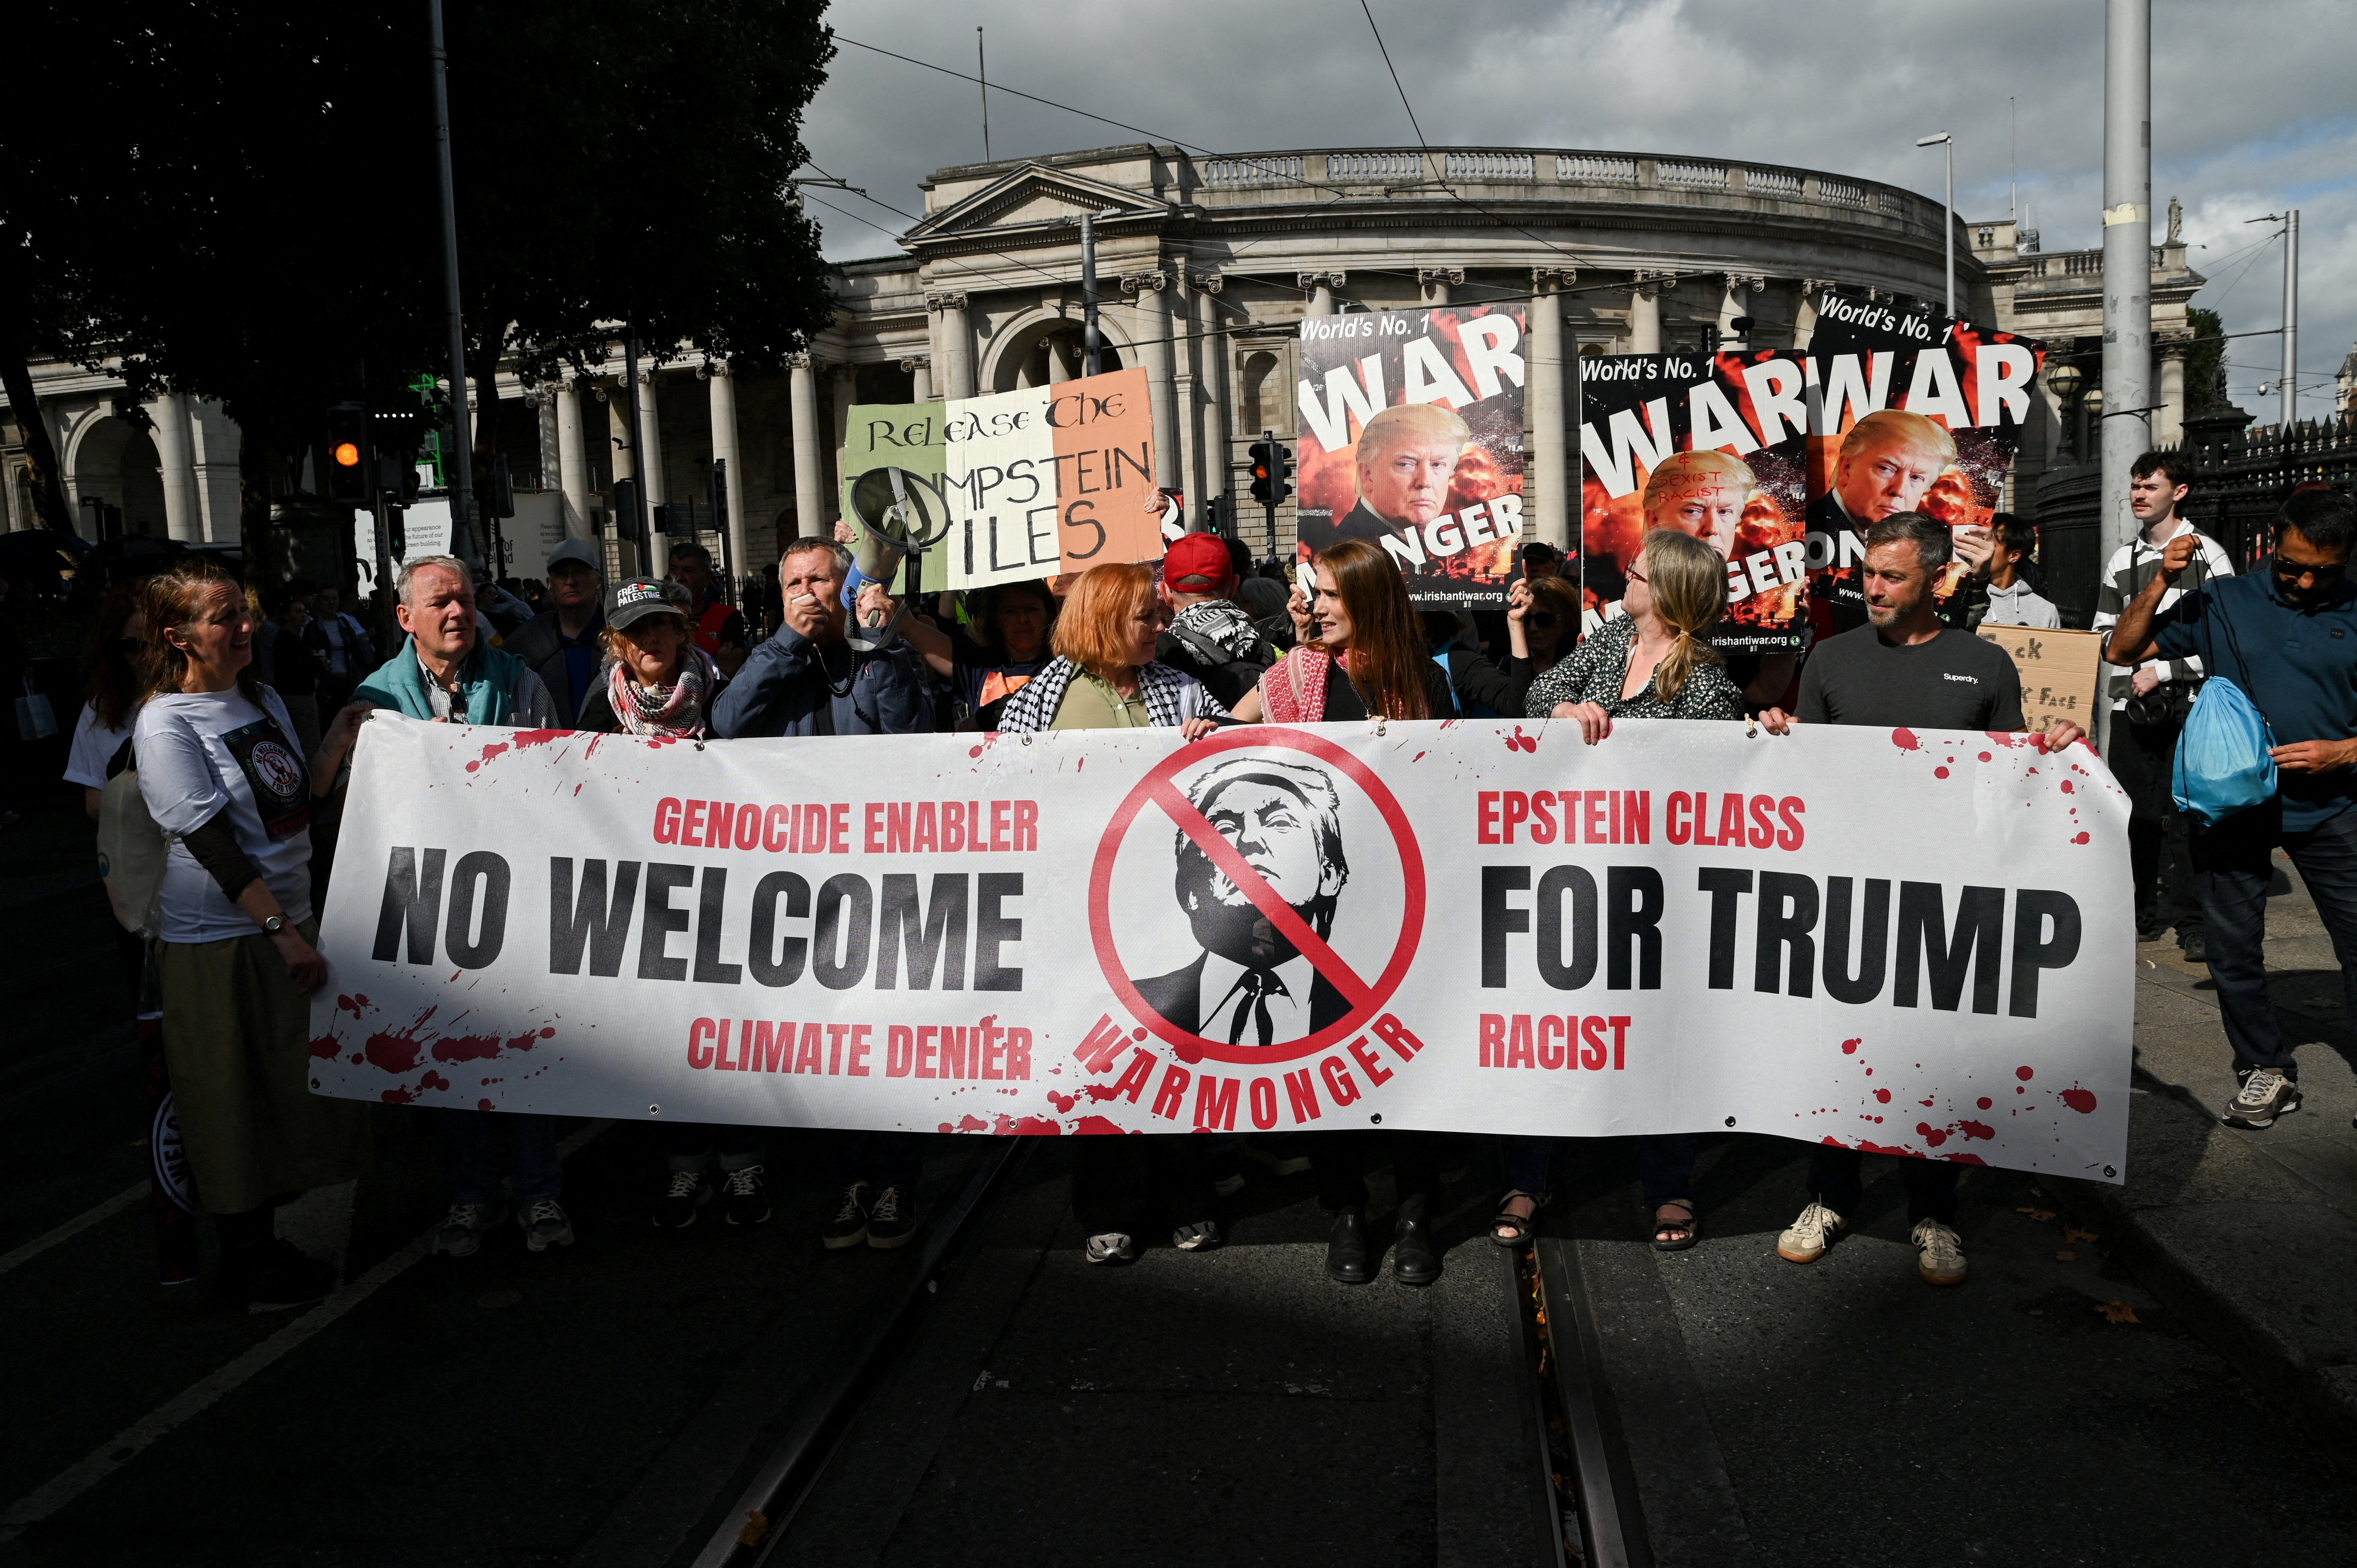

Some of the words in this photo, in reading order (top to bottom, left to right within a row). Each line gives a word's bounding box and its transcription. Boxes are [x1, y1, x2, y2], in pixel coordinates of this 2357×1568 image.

[1301, 317, 1373, 341] World's
[1379, 315, 1412, 337] No.
[1420, 313, 1430, 334] 1
[1819, 295, 1896, 332] World's
[1899, 317, 1931, 341] No.
[1940, 324, 1954, 344] 1
[1298, 313, 1525, 453] WAR
[1582, 358, 1657, 382] World's
[1664, 357, 1697, 379] No.
[1705, 356, 1715, 377] 1
[1806, 343, 2034, 437] WAR
[1582, 358, 1807, 500] WAR
[921, 500, 1106, 575] ILES
[1296, 494, 1523, 603] MNGER
[617, 583, 639, 599] FREE
[618, 591, 661, 607] PALESTINE
[1943, 673, 1979, 685] Superdry.
[256, 754, 263, 764] NO
[257, 744, 288, 758] WELCOME
[273, 781, 284, 792] FOR
[285, 773, 299, 793] TRUMP
[653, 796, 850, 854] GENOCIDE
[864, 799, 1039, 853] ENABLER
[1477, 790, 1650, 845] EPSTEIN
[1666, 790, 1805, 852] CLASS
[371, 846, 511, 970] NO
[549, 856, 1024, 992] WELCOME
[1481, 865, 1664, 991] FOR
[1698, 866, 2082, 1019] TRUMP
[687, 1016, 872, 1077] CLIMATE
[885, 1024, 1033, 1081] DENIER
[1479, 1013, 1631, 1071] RACIST
[1072, 1012, 1425, 1131] WARMONGER
